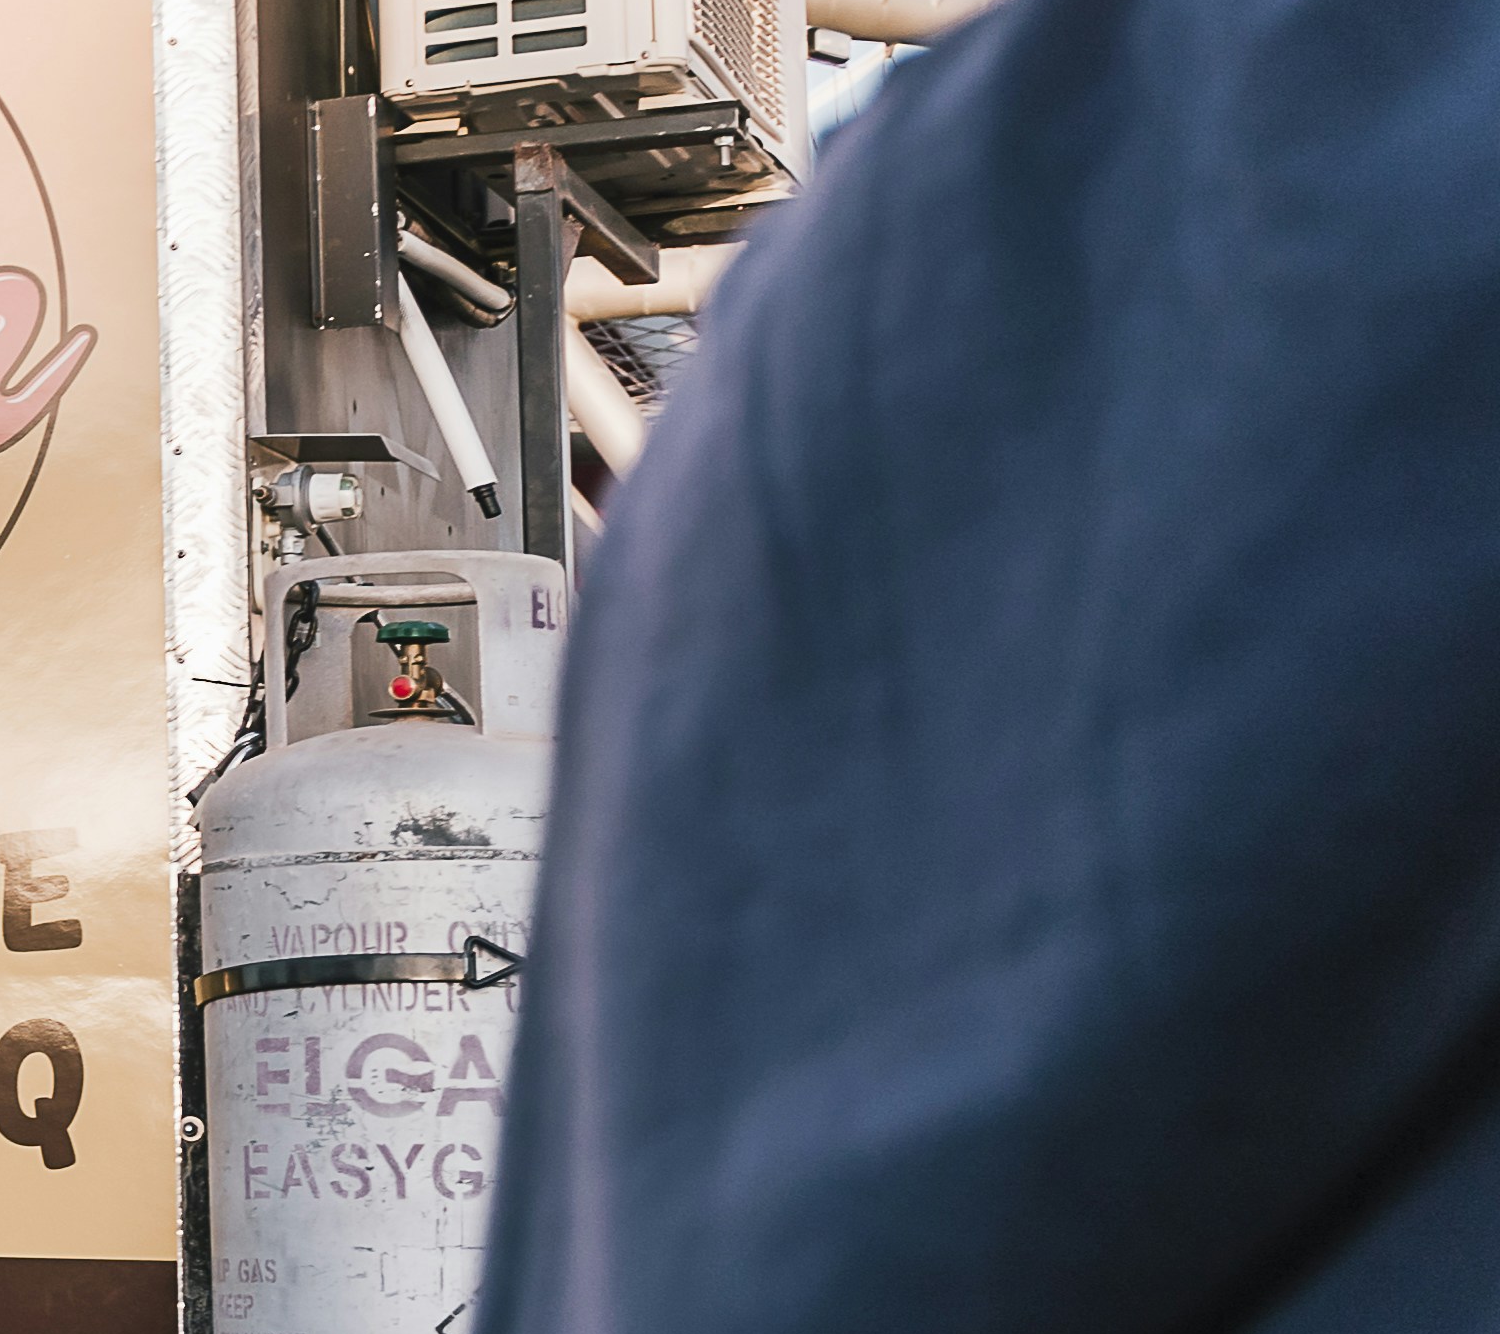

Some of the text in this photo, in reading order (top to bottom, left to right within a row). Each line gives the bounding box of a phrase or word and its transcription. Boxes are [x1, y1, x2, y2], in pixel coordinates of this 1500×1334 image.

[255, 1032, 504, 1118] ELGA
[243, 1143, 484, 1200] EASYG
[238, 1259, 277, 1283] GAS
